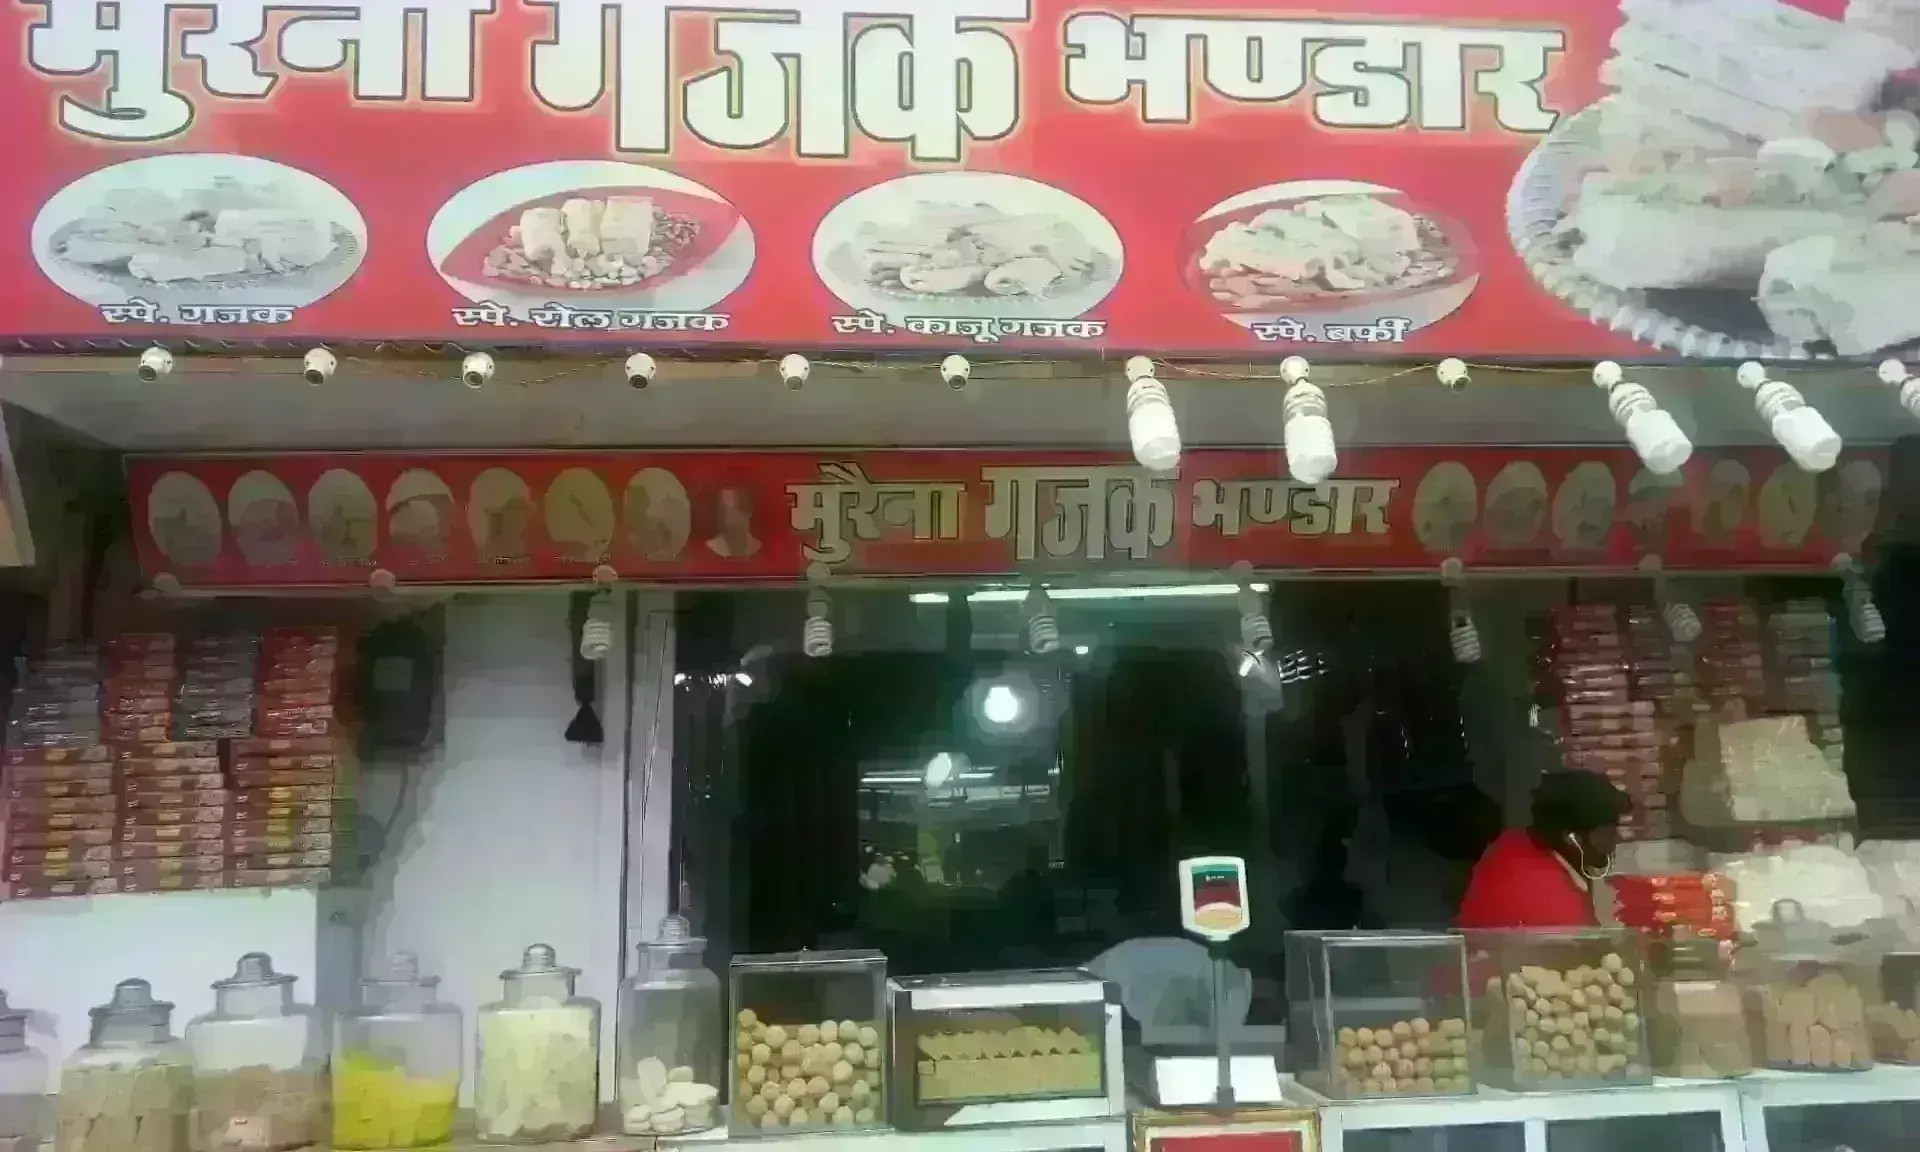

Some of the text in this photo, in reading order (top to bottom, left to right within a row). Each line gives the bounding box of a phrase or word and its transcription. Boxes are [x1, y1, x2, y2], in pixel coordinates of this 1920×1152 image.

[522, 0, 1031, 161] गजक
[1065, 12, 1566, 132] भण्डार
[177, 304, 297, 325] गजक
[616, 308, 731, 331] गजक
[904, 315, 999, 342] काजू
[999, 318, 1107, 338] गजक
[786, 461, 1400, 564] मुरैना गजक भण्डार
